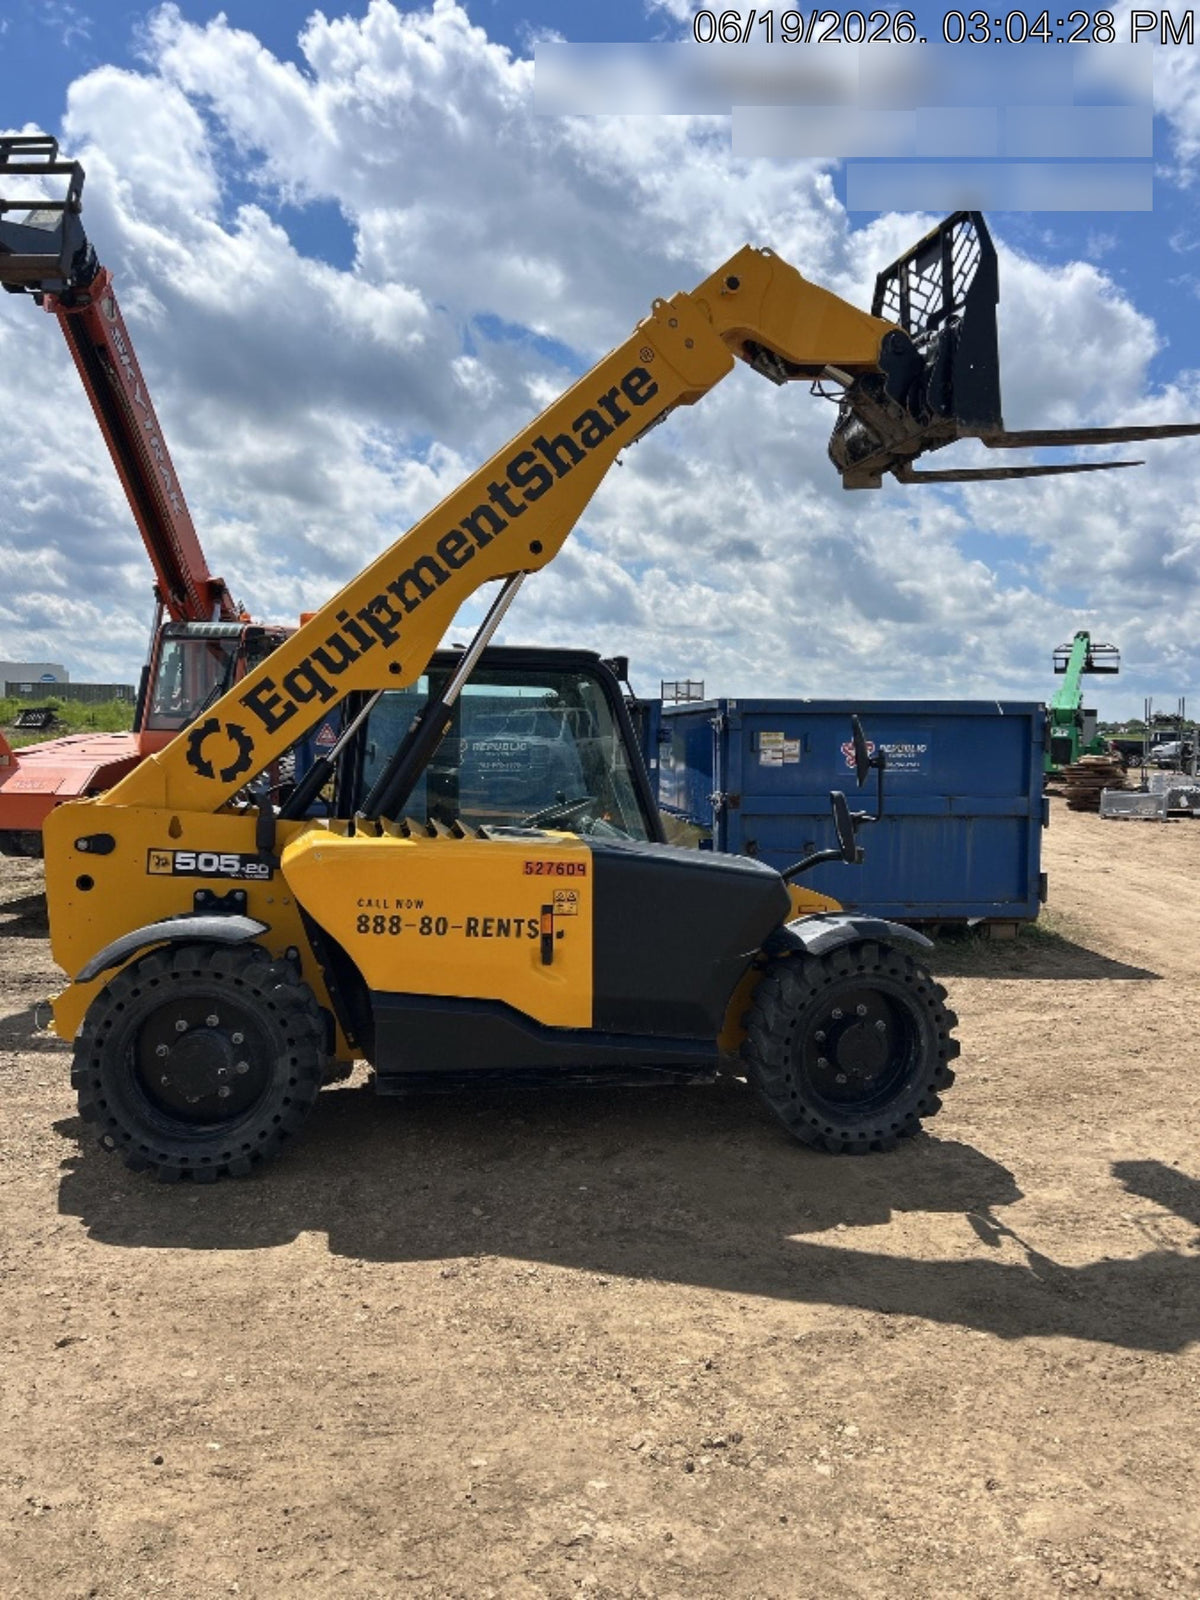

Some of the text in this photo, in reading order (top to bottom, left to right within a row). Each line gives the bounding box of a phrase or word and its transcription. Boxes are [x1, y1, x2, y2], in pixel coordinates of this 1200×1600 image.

[242, 366, 659, 733] EquipmentShare
[175, 852, 269, 874] 505-20
[525, 861, 586, 876] 527609
[357, 898, 424, 910] CALL NOW
[356, 914, 540, 940] 888-80-RENTS
